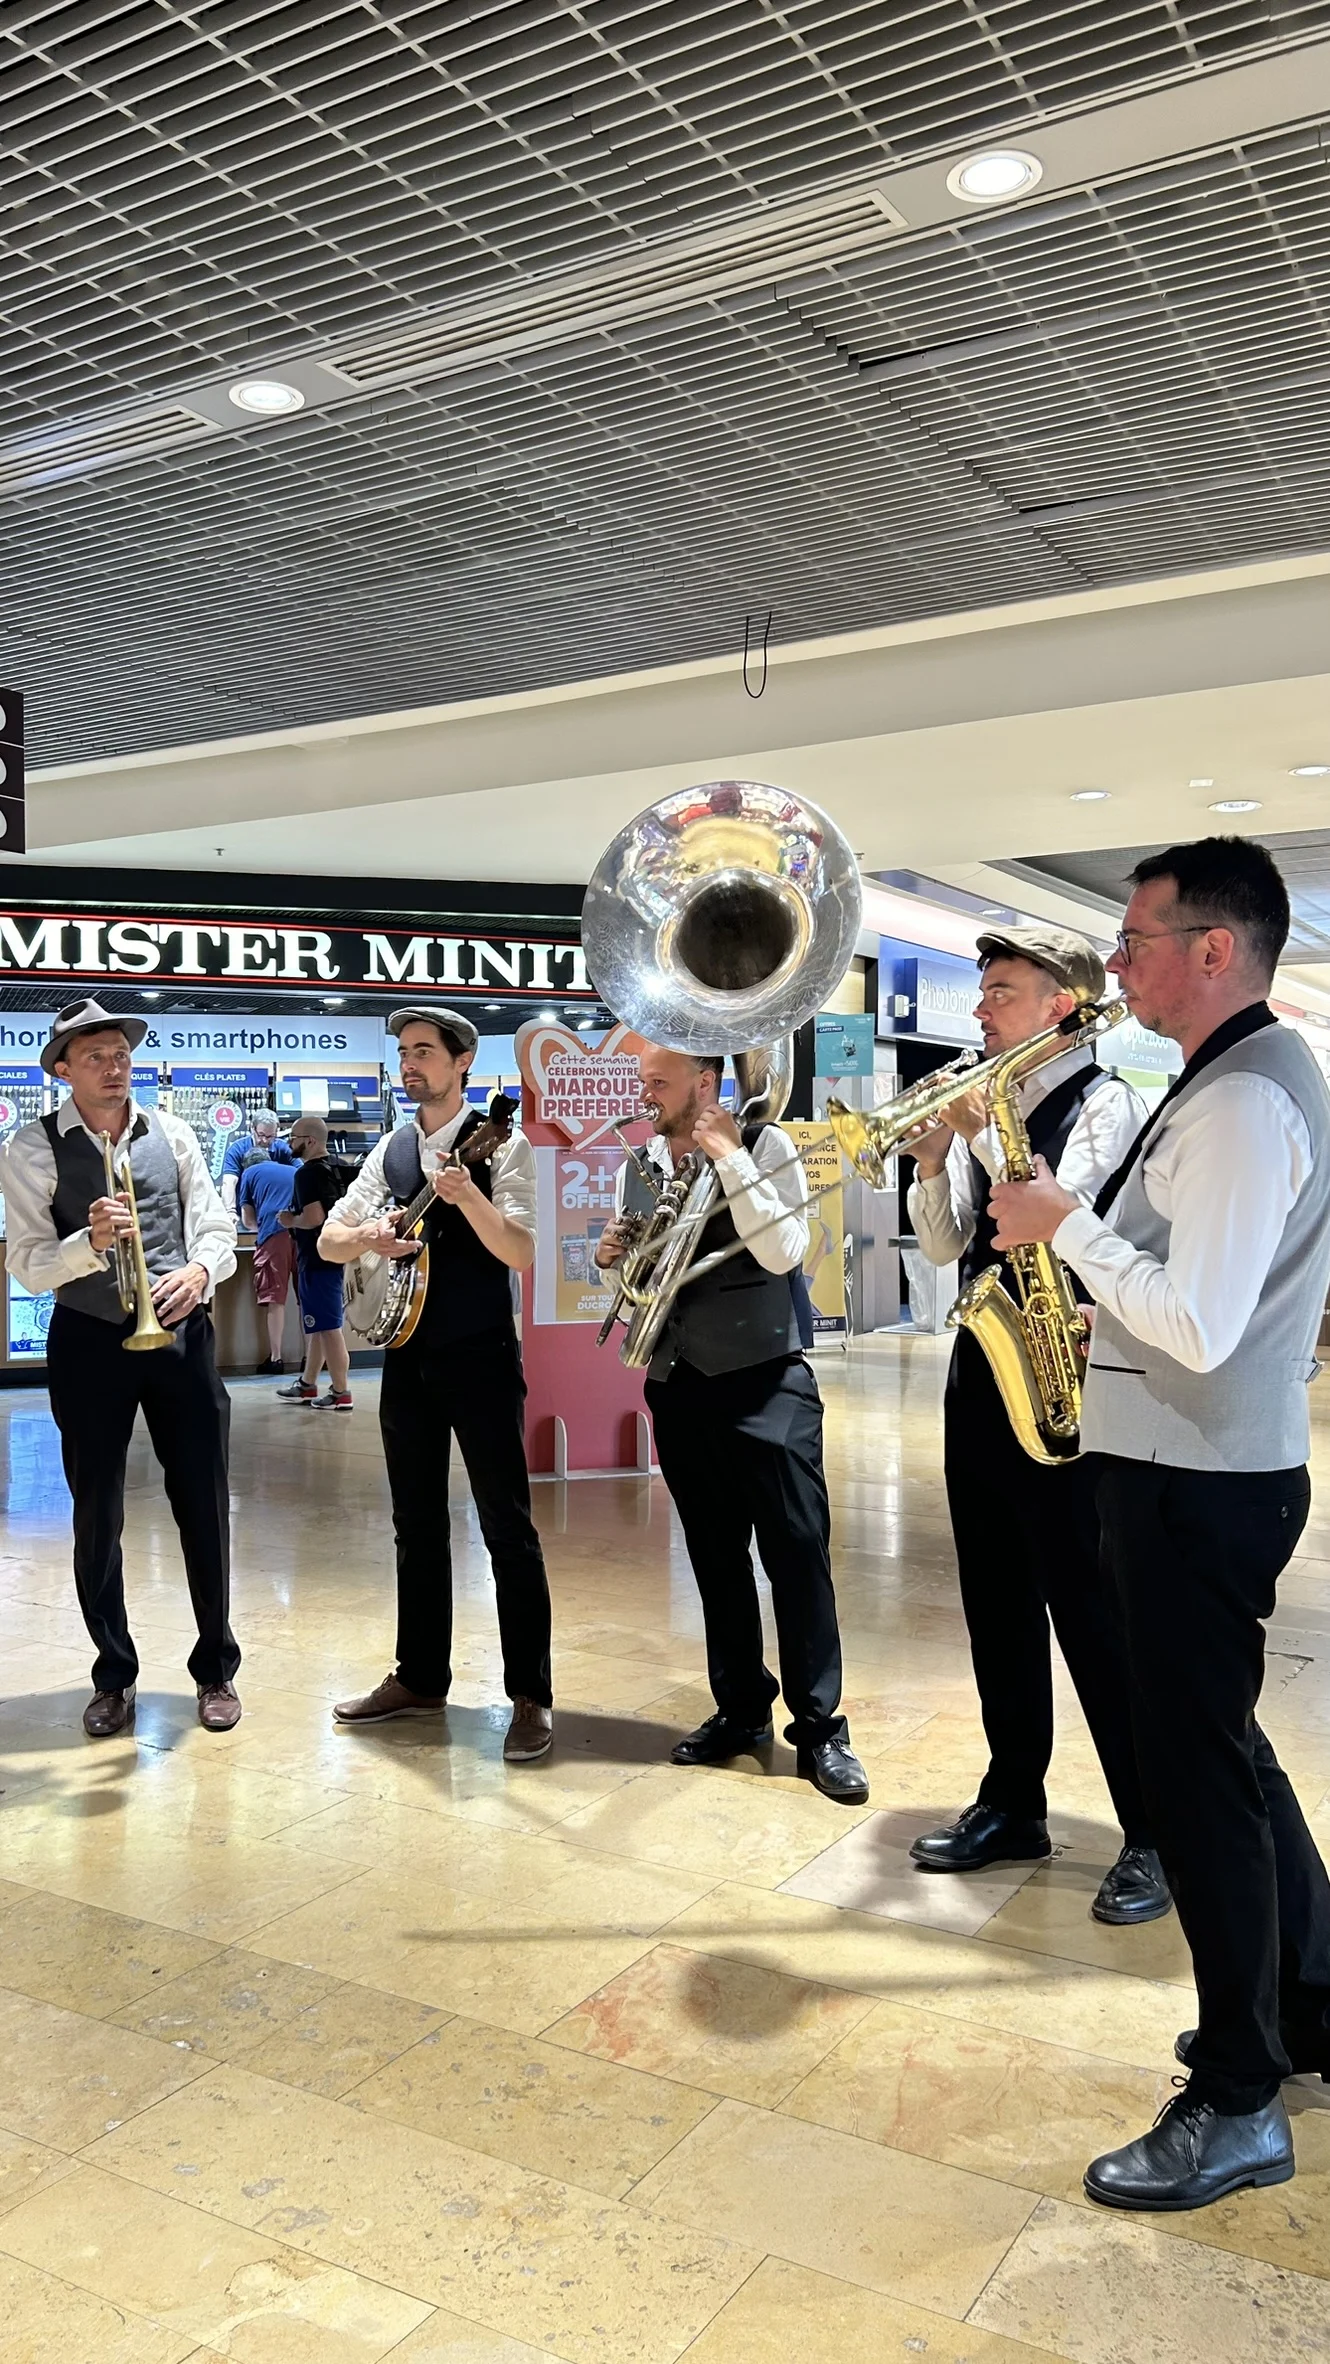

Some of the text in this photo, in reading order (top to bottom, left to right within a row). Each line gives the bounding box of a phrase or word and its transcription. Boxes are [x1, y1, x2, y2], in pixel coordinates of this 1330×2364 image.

[0, 916, 592, 990] MISTER MINIT
[145, 1030, 161, 1048] &
[171, 1028, 348, 1053] smartphones
[551, 1053, 638, 1065] Cette semaine
[607, 1067, 639, 1076] VOTRE
[130, 1073, 153, 1081] QUES
[194, 1073, 215, 1081] CLÉS
[548, 1078, 640, 1097] MARQUE
[798, 1131, 812, 1140] ICI,
[802, 1157, 838, 1165] ARATION
[808, 1184, 831, 1192] URES
[561, 1193, 616, 1209] OFFE
[577, 1301, 612, 1310] DUCRO
